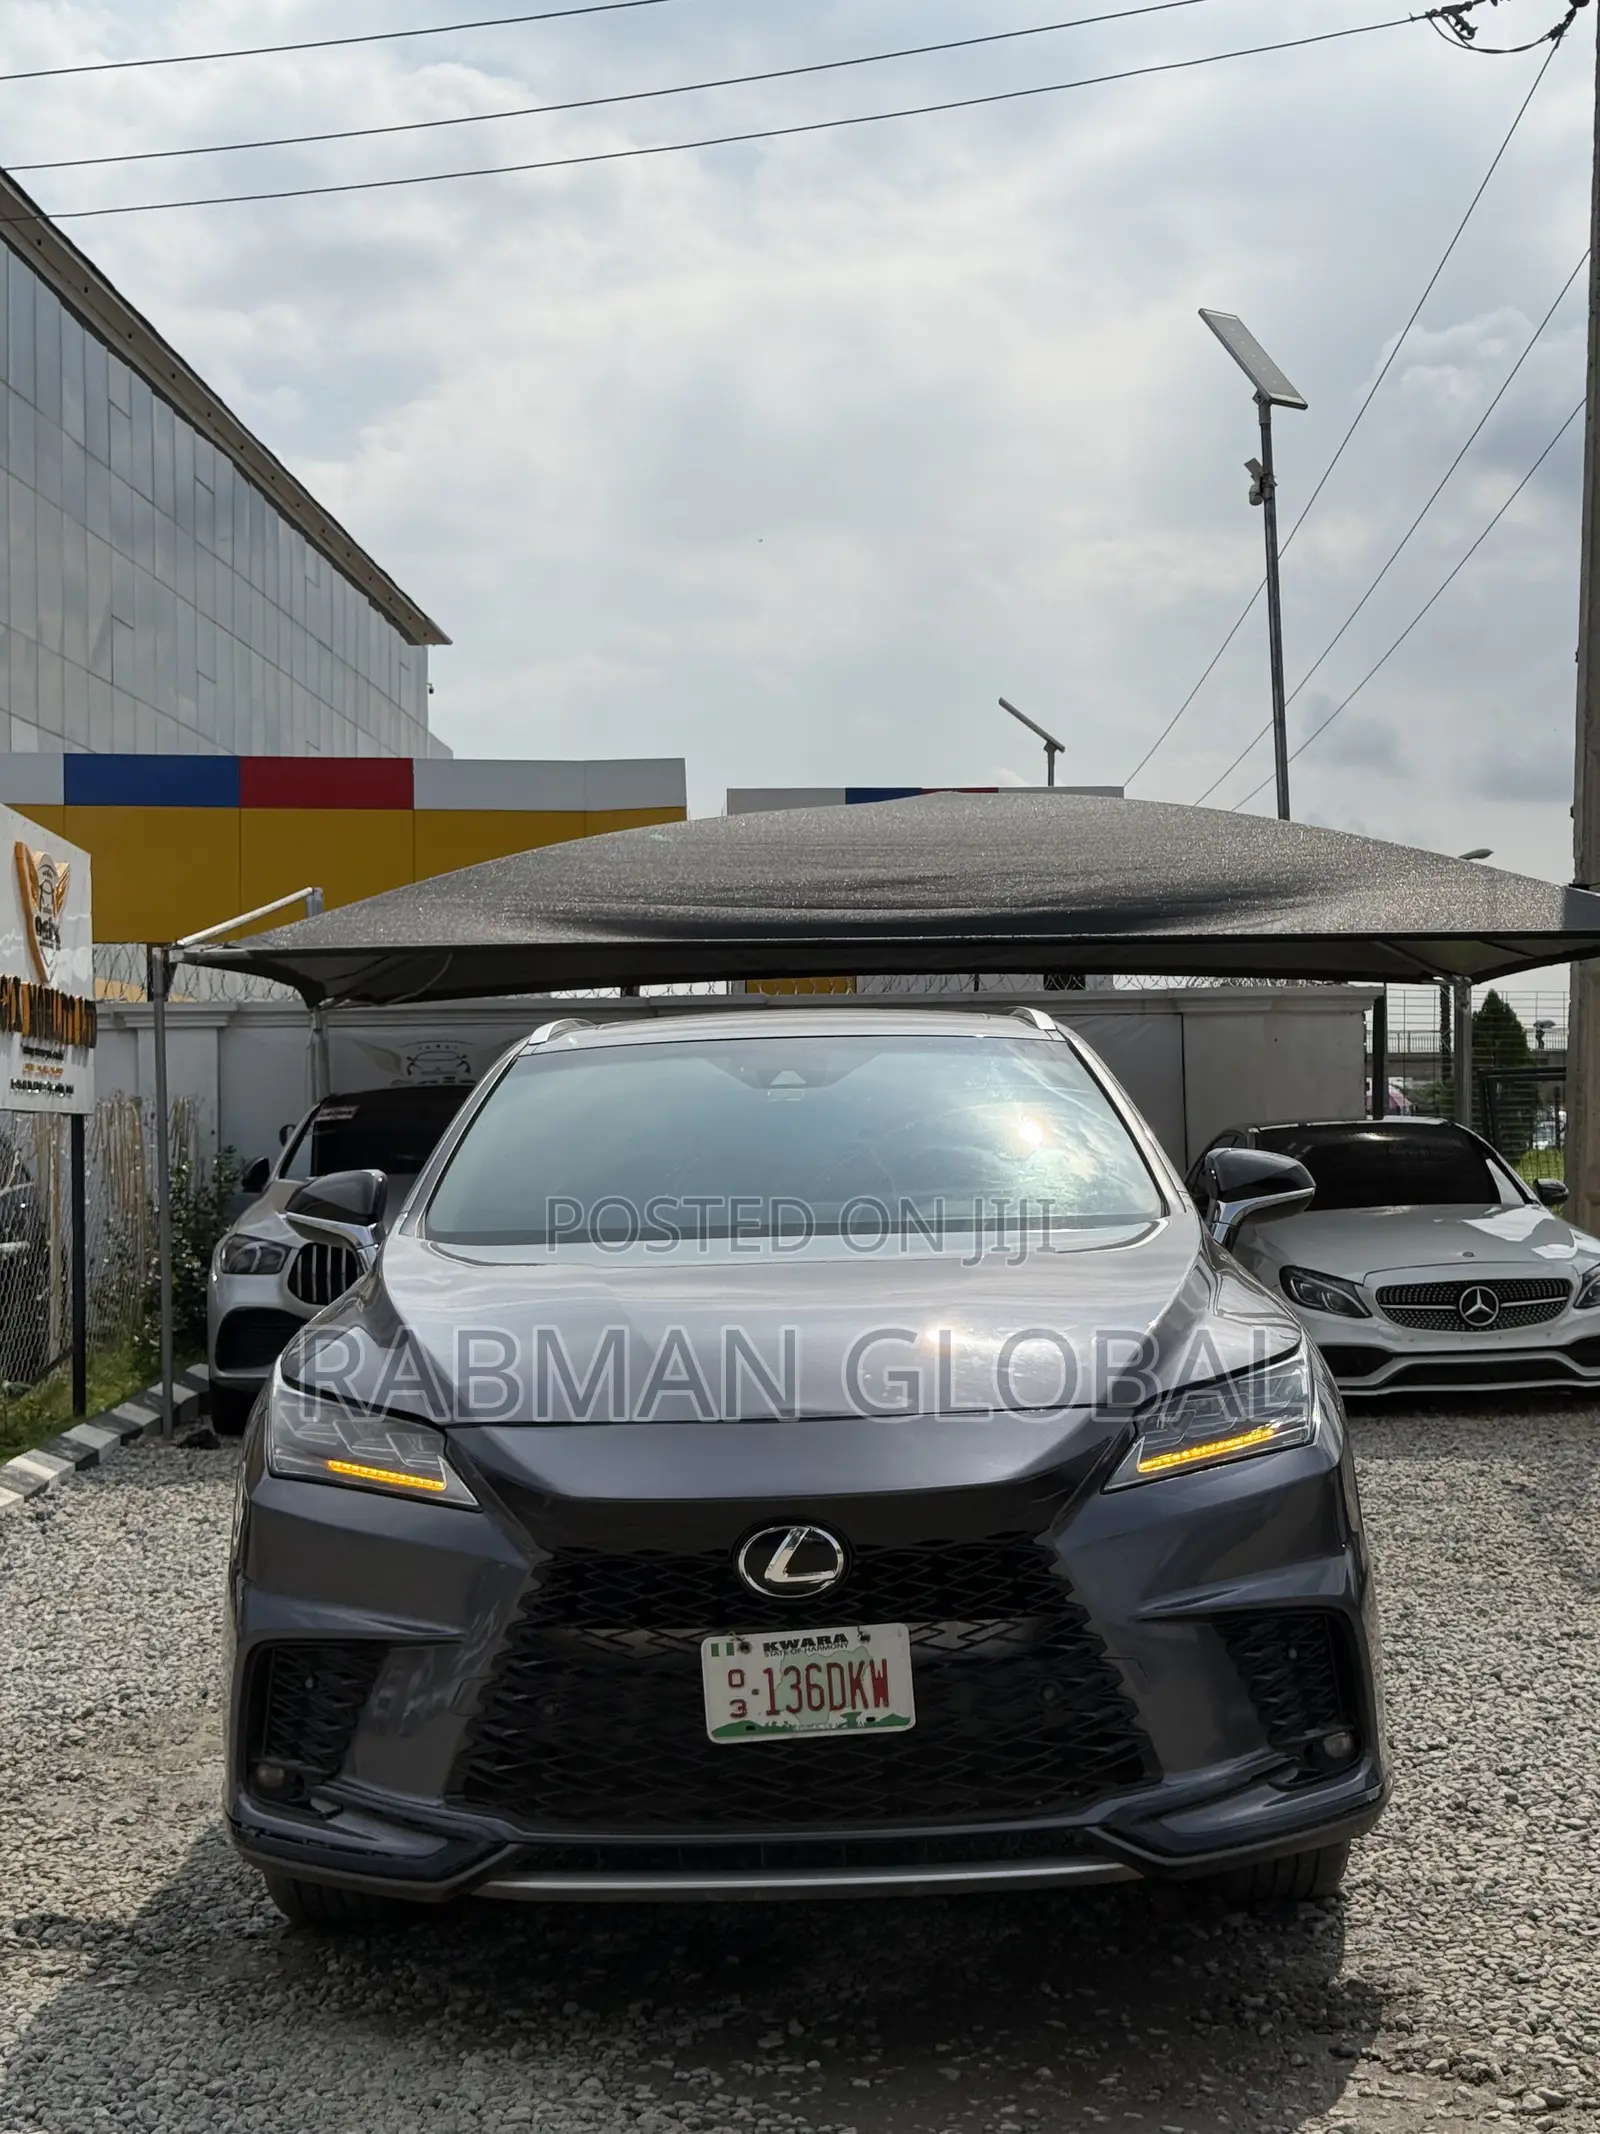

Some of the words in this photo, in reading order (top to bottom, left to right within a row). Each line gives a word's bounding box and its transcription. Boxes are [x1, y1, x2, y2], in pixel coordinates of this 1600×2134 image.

[763, 1633, 849, 1652] KWARA
[803, 1641, 849, 1654] HARMONY
[763, 1658, 890, 1716] 136DKW
